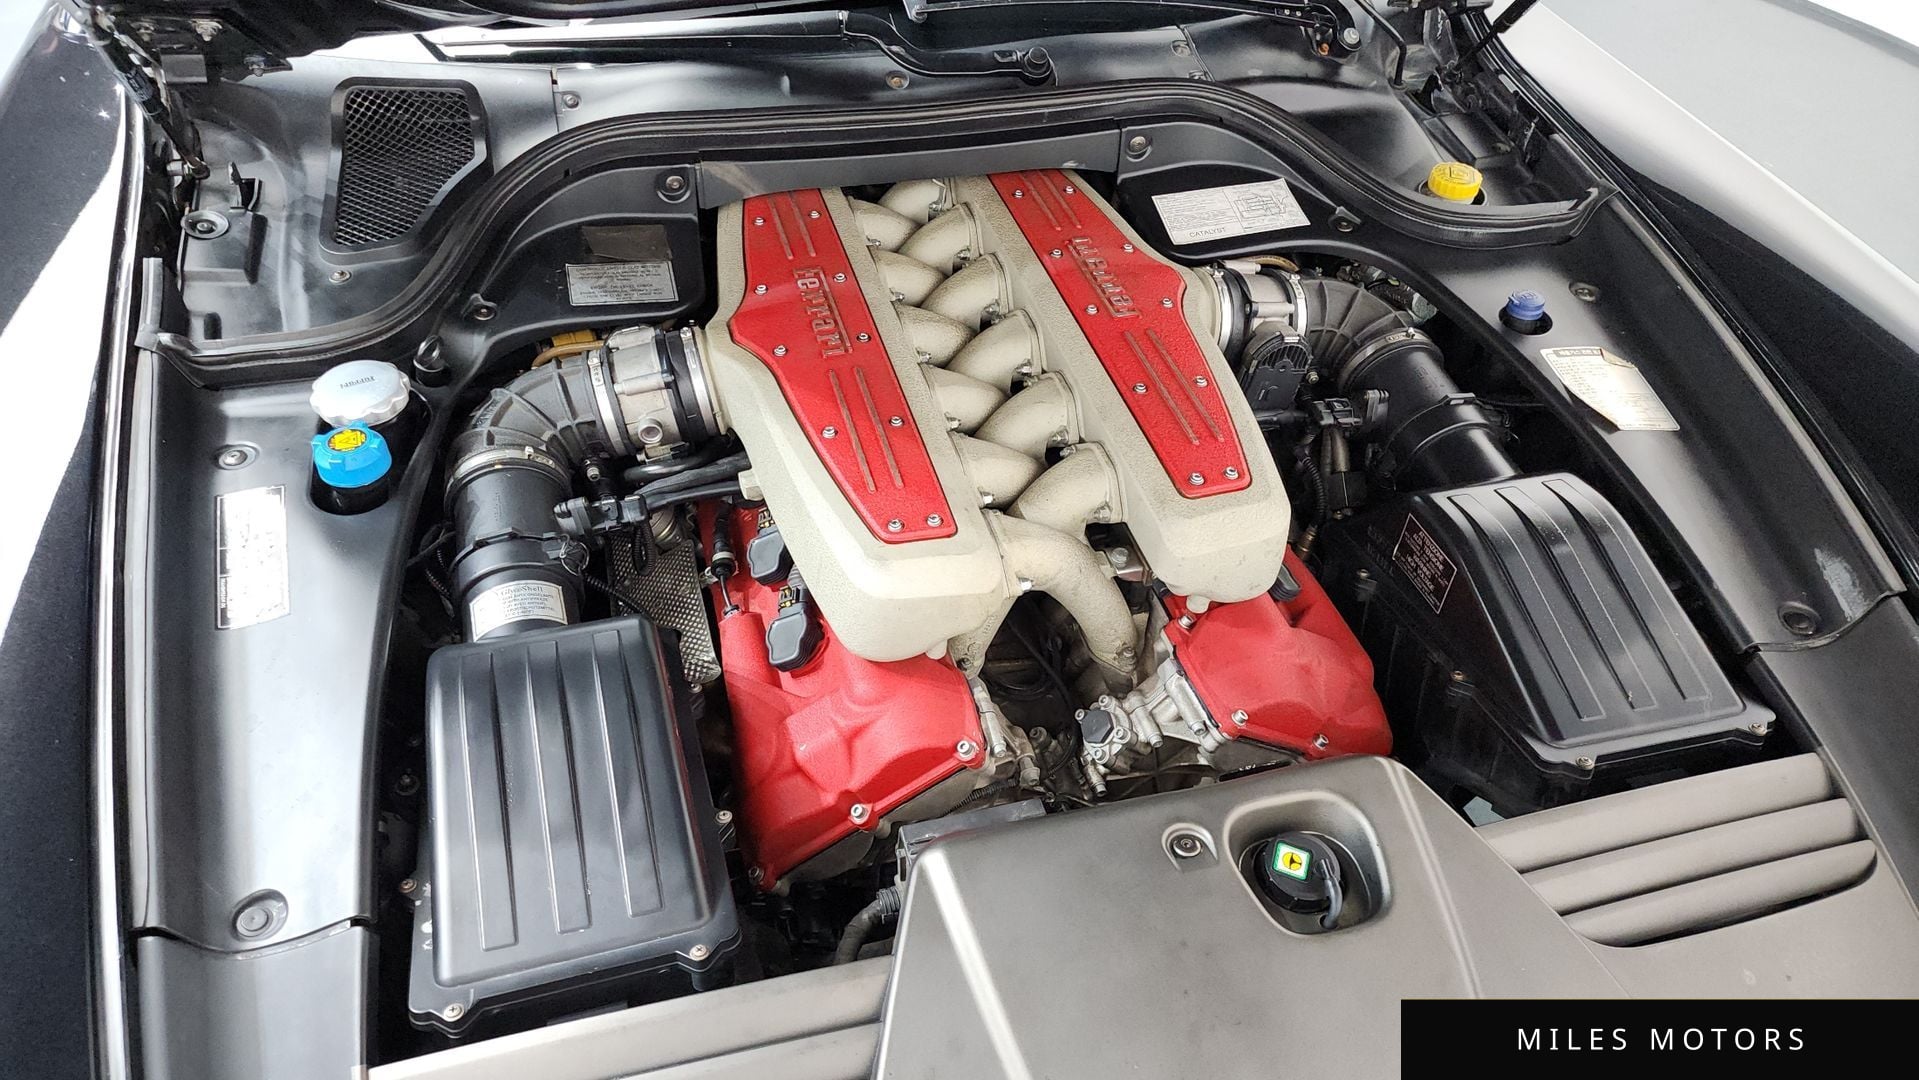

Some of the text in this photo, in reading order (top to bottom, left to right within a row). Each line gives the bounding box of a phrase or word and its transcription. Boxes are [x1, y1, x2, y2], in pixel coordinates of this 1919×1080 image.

[1189, 227, 1226, 238] CATALYST
[793, 266, 852, 359] Ferrari
[1065, 238, 1142, 319] Ferrari
